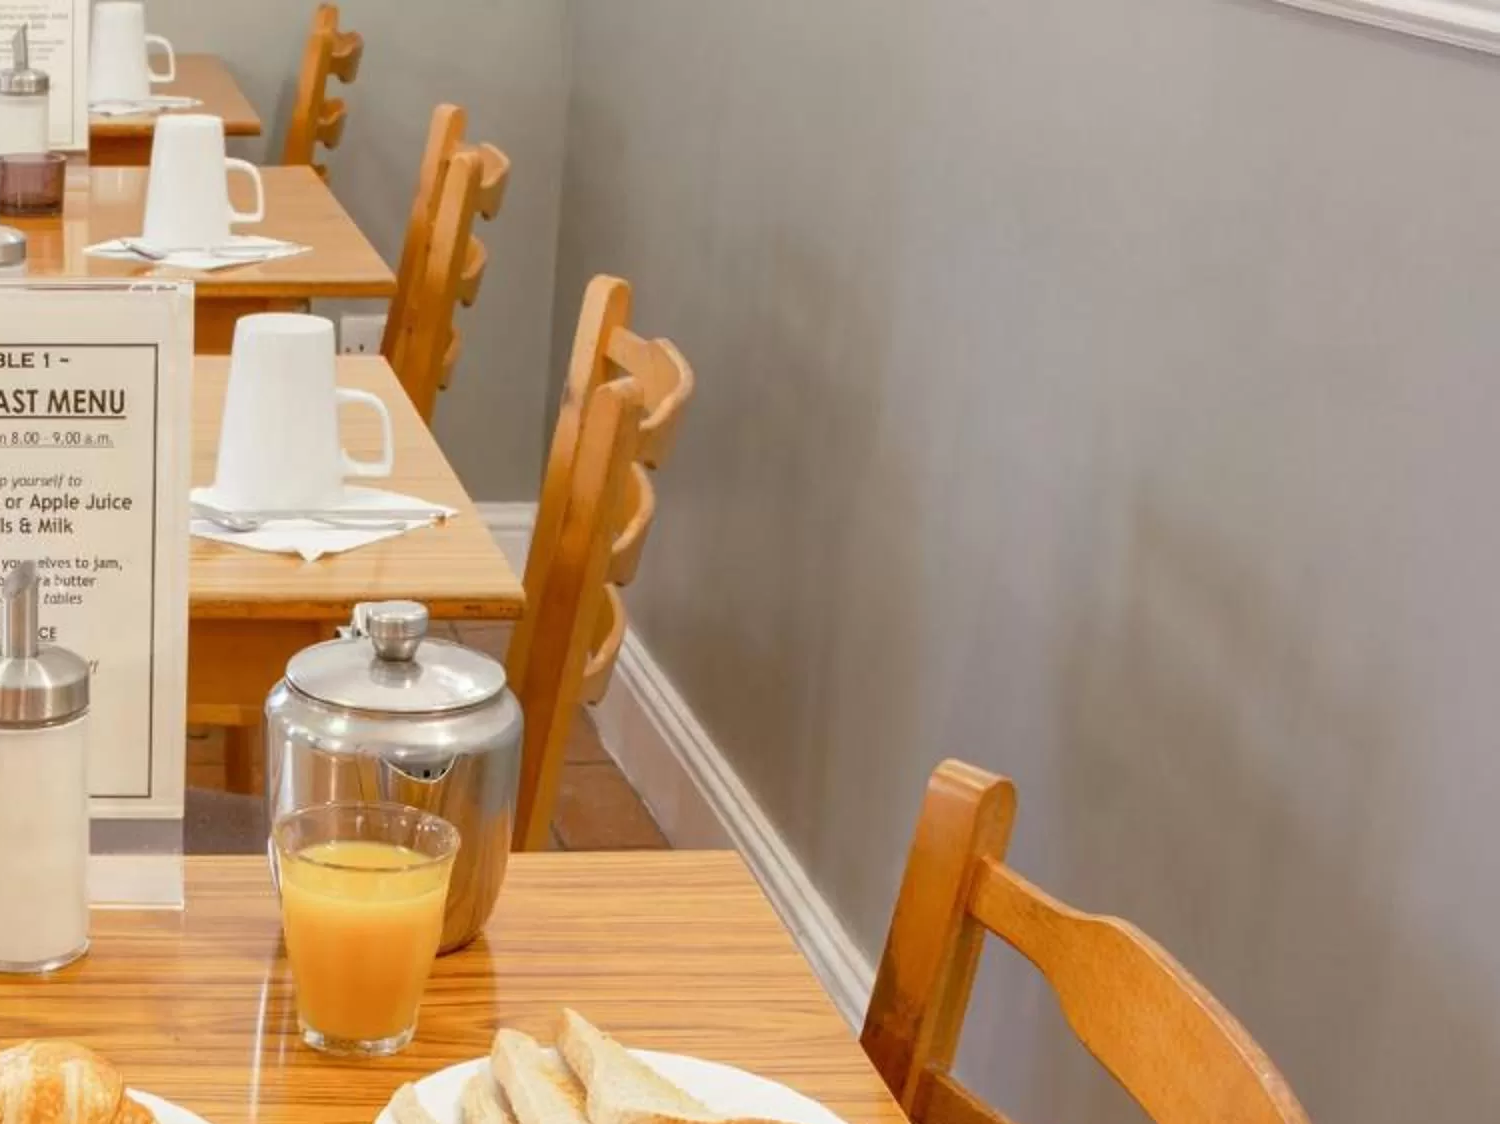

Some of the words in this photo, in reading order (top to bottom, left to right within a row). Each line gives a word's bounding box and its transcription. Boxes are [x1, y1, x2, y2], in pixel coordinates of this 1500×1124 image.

[43, 352, 51, 369] 1
[47, 389, 125, 415] MENU
[12, 431, 40, 446] 8.00
[52, 432, 81, 447] 9.00
[85, 433, 114, 447] a.m.
[11, 474, 65, 489] yourself
[68, 475, 83, 487] to
[5, 496, 24, 510] or
[30, 493, 79, 514] Apple
[85, 493, 133, 511] Juice
[19, 517, 33, 535] &
[38, 517, 74, 535] Milk
[75, 557, 90, 569] to
[92, 556, 123, 573] jam,
[54, 575, 98, 587] butter
[43, 592, 84, 605] tables
